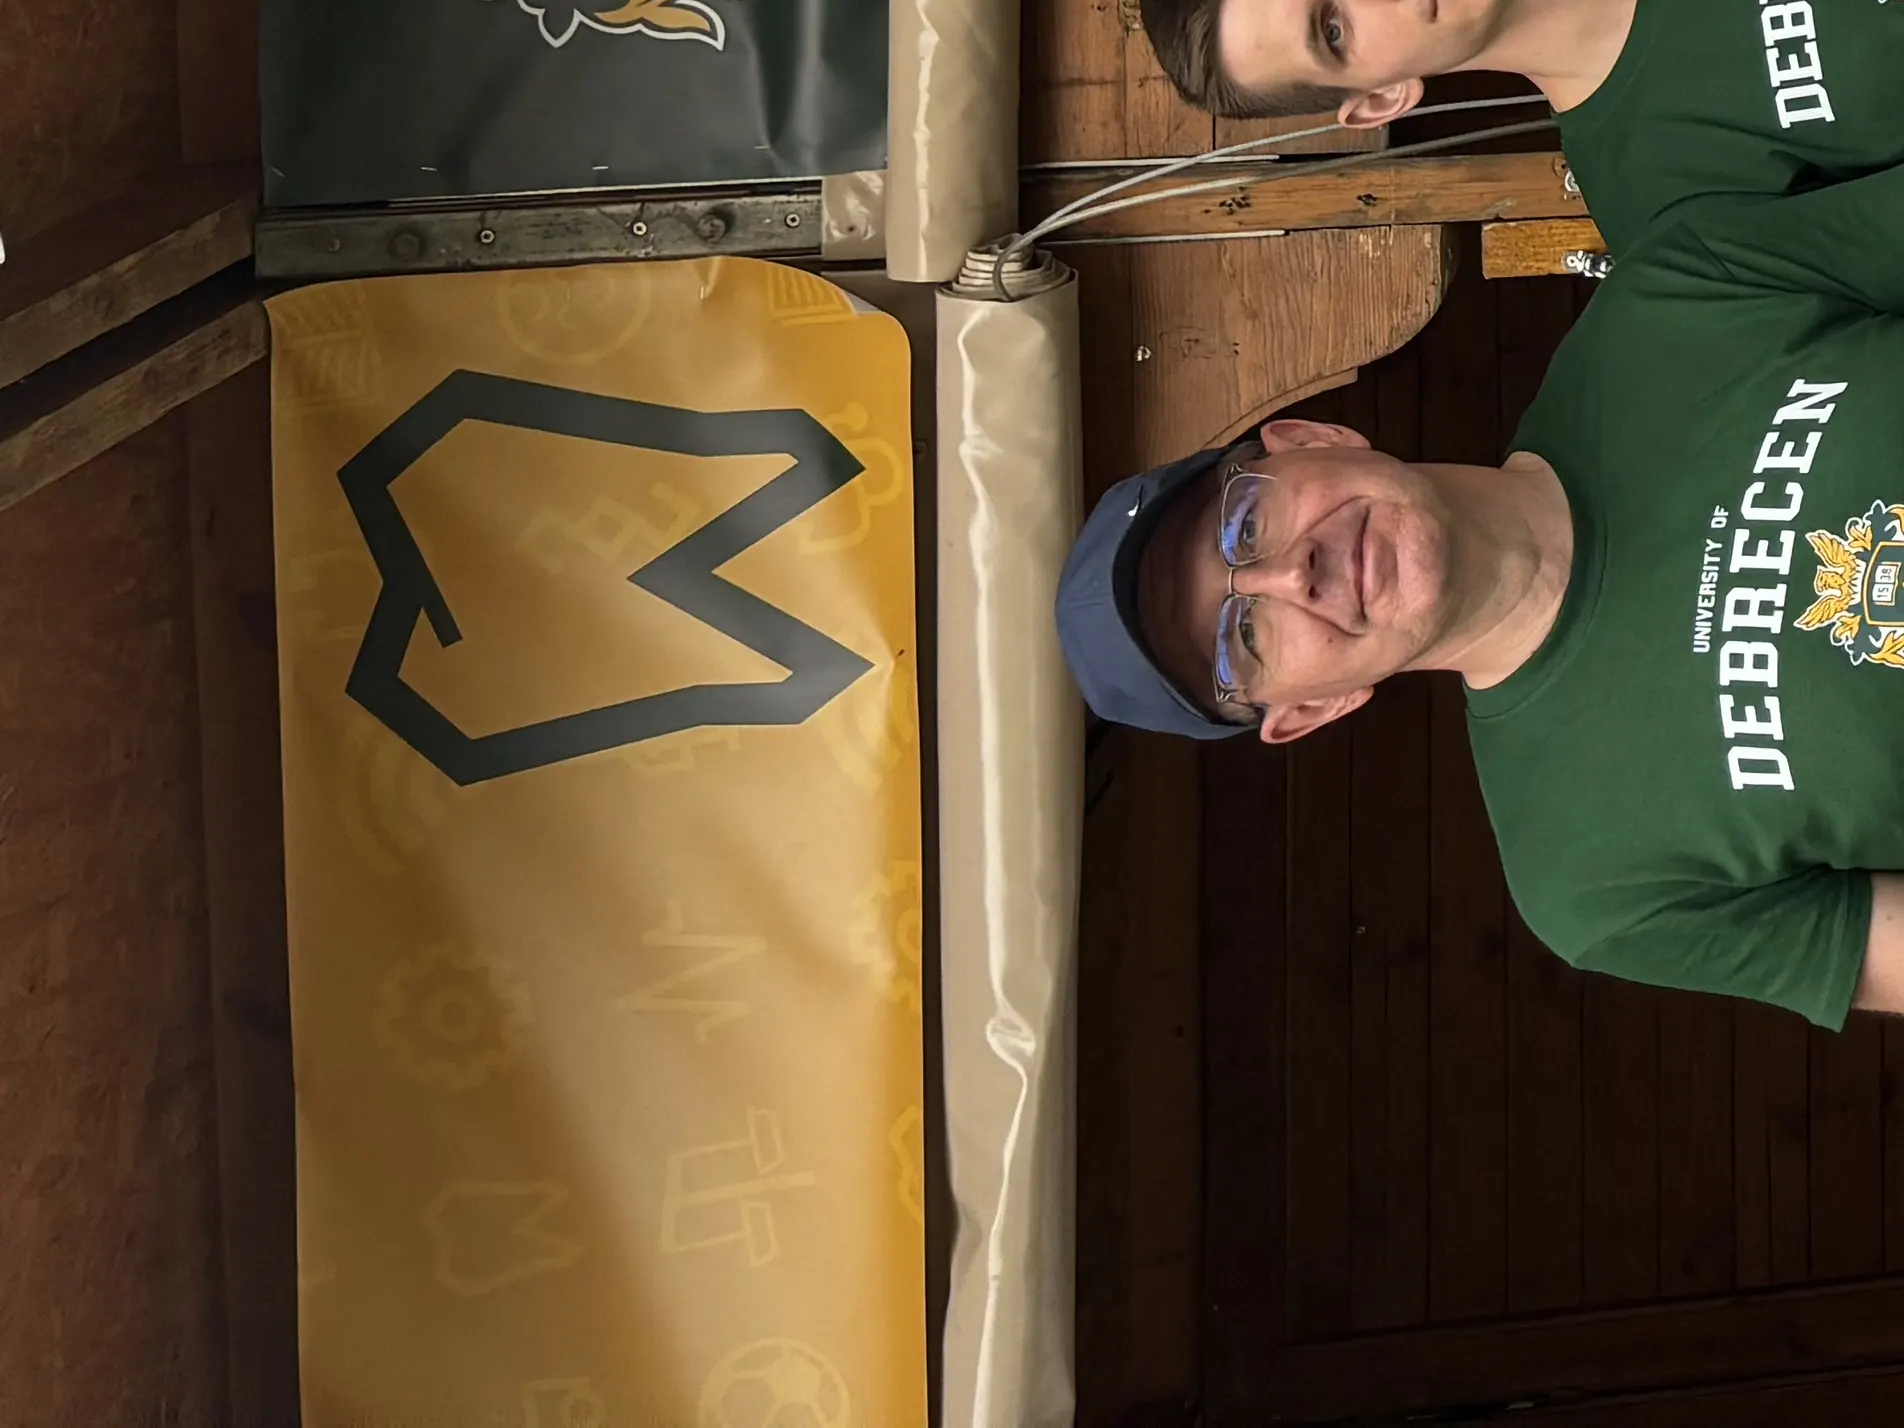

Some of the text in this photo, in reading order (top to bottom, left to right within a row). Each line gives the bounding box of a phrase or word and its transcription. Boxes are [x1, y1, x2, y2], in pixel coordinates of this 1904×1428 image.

[1693, 505, 1729, 653] UNIVERSITY OF
[1718, 378, 1849, 790] DEBRECEN
